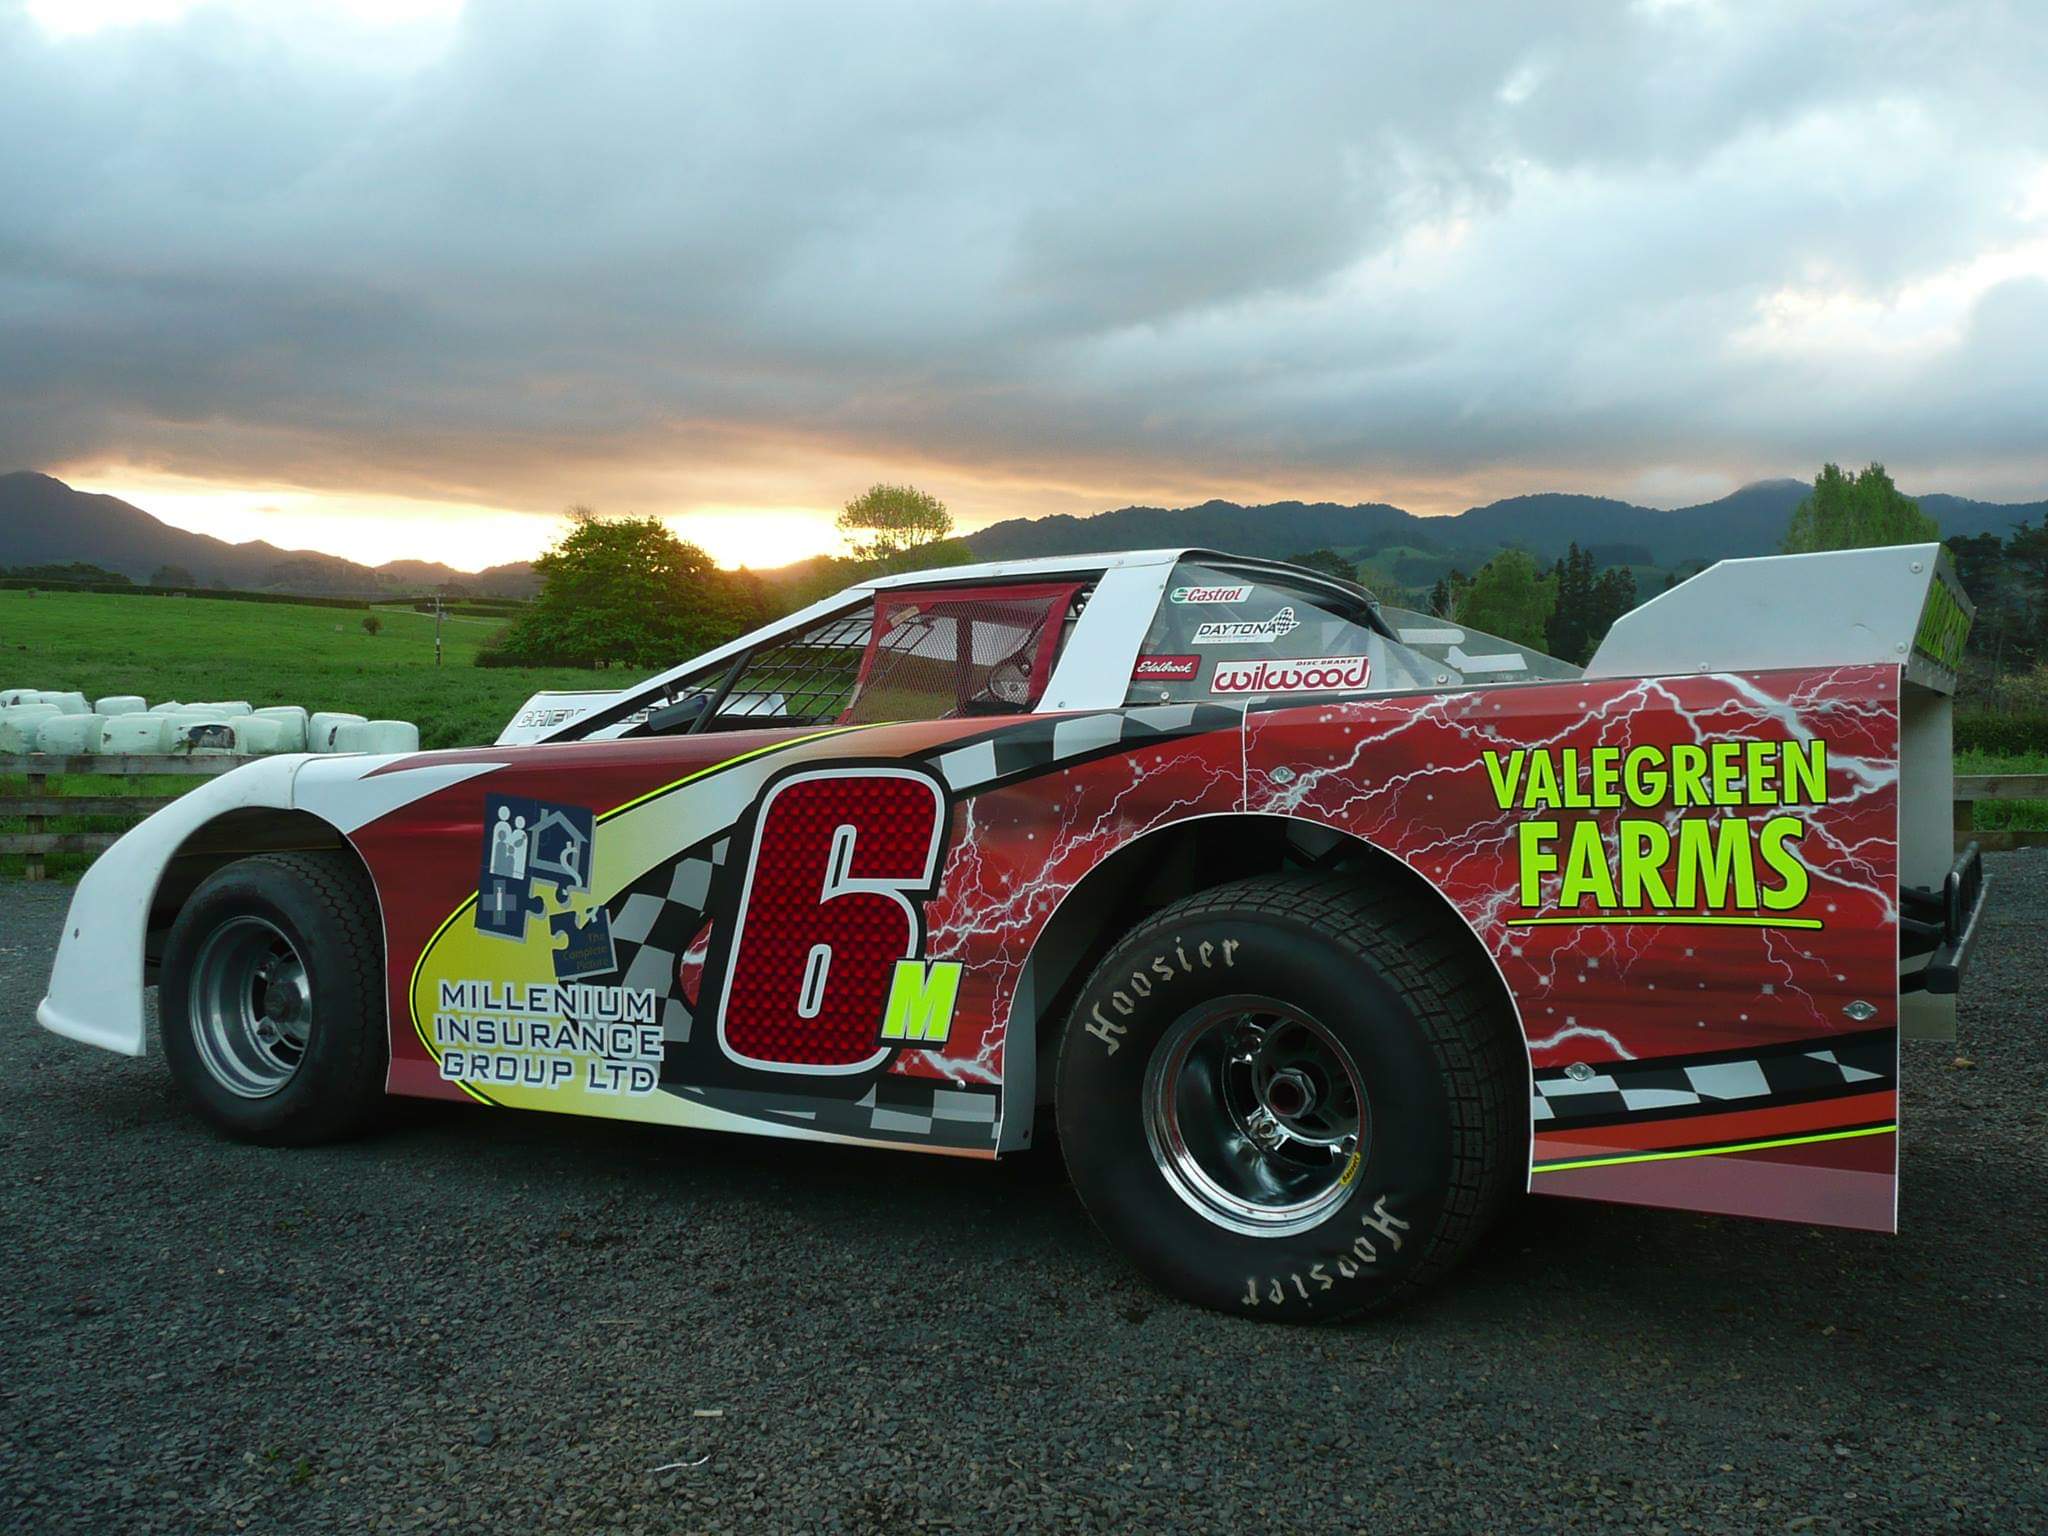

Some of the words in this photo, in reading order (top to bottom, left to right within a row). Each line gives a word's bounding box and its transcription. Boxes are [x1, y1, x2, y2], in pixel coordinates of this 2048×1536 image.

[1186, 587, 1243, 601] Castrol
[1198, 623, 1277, 636] DAYTONA
[1214, 656, 1369, 691] wilwood
[1320, 658, 1359, 666] BRAKES
[1482, 739, 1828, 810] VALEGREEN
[1517, 815, 1810, 912] FARMS
[716, 766, 946, 1076] 6
[880, 959, 964, 1042] M
[440, 980, 656, 1021] MILLENIUM
[1085, 936, 1240, 1056] Hoosier
[435, 1016, 662, 1058] INSURANCE
[441, 1050, 574, 1087] GROUP
[586, 1060, 657, 1094] LTD
[1240, 1195, 1411, 1308] Hoosier
